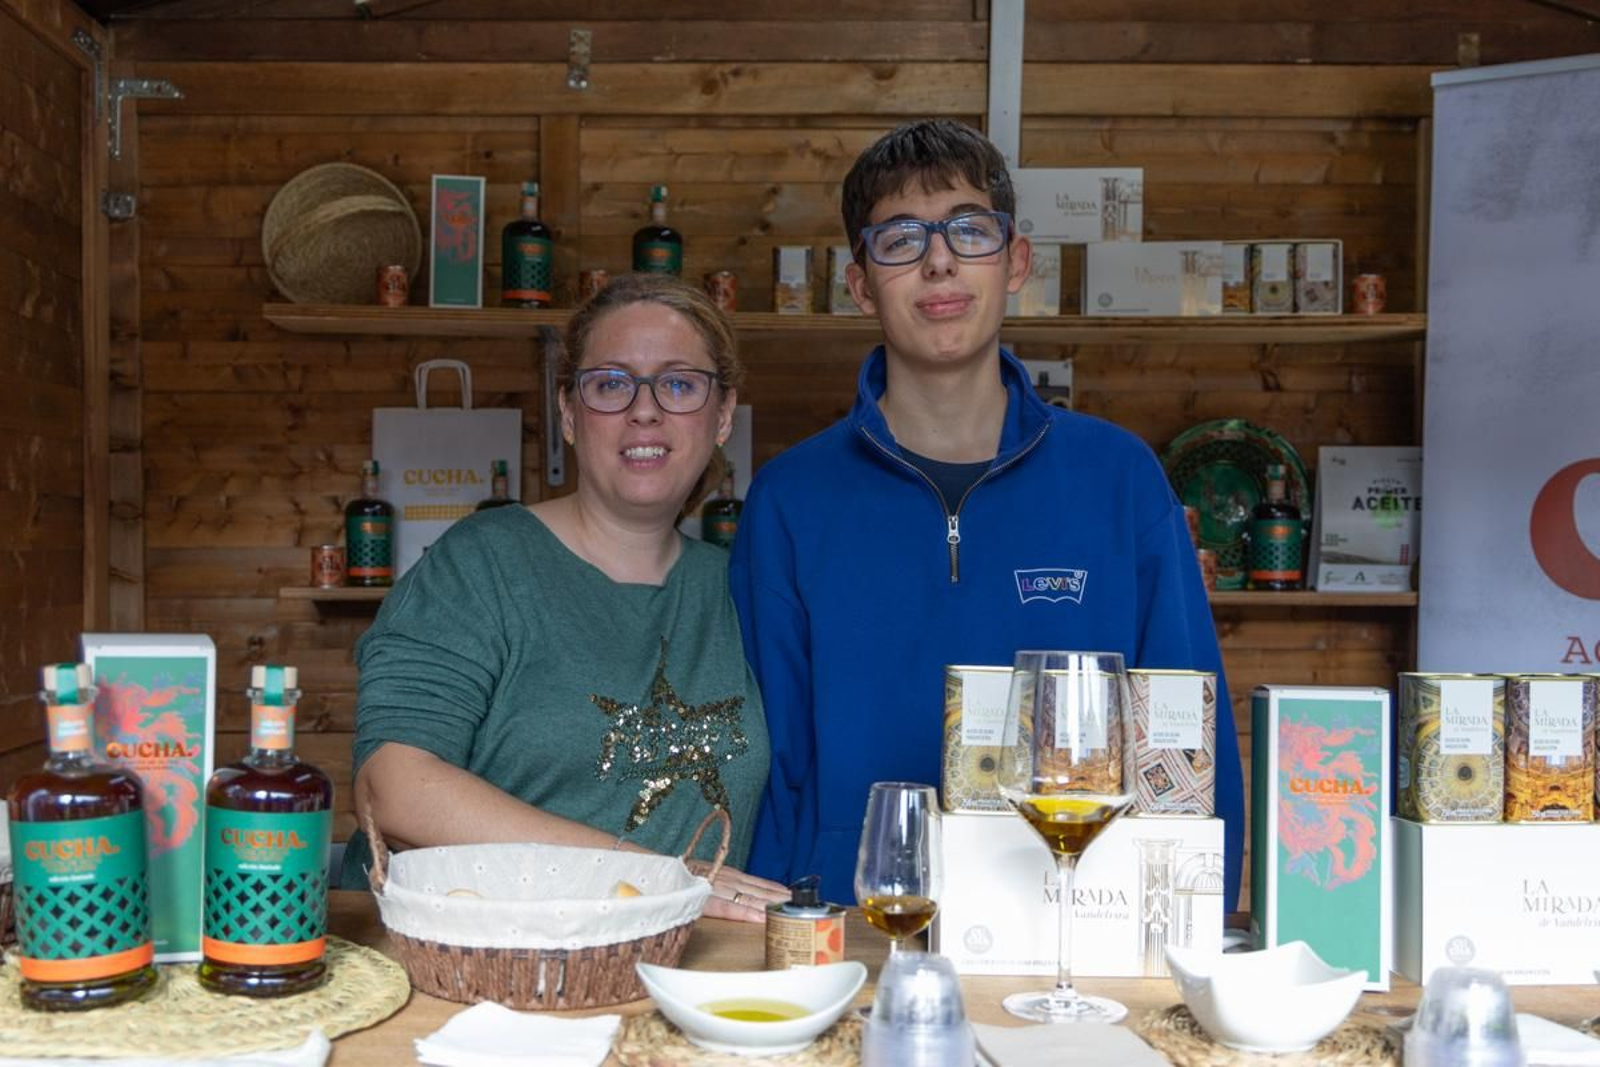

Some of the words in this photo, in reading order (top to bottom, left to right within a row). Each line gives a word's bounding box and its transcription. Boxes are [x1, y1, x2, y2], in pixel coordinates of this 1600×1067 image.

[404, 469, 484, 486] CUCHA.
[1351, 495, 1422, 512] ACEITE
[105, 741, 193, 758] CUCHA.
[1289, 778, 1371, 795] CUCHA.
[221, 827, 308, 849] CUCHA.
[25, 835, 121, 861] CUCHA.
[1523, 878, 1550, 895] LA
[1043, 887, 1128, 906] MRADA
